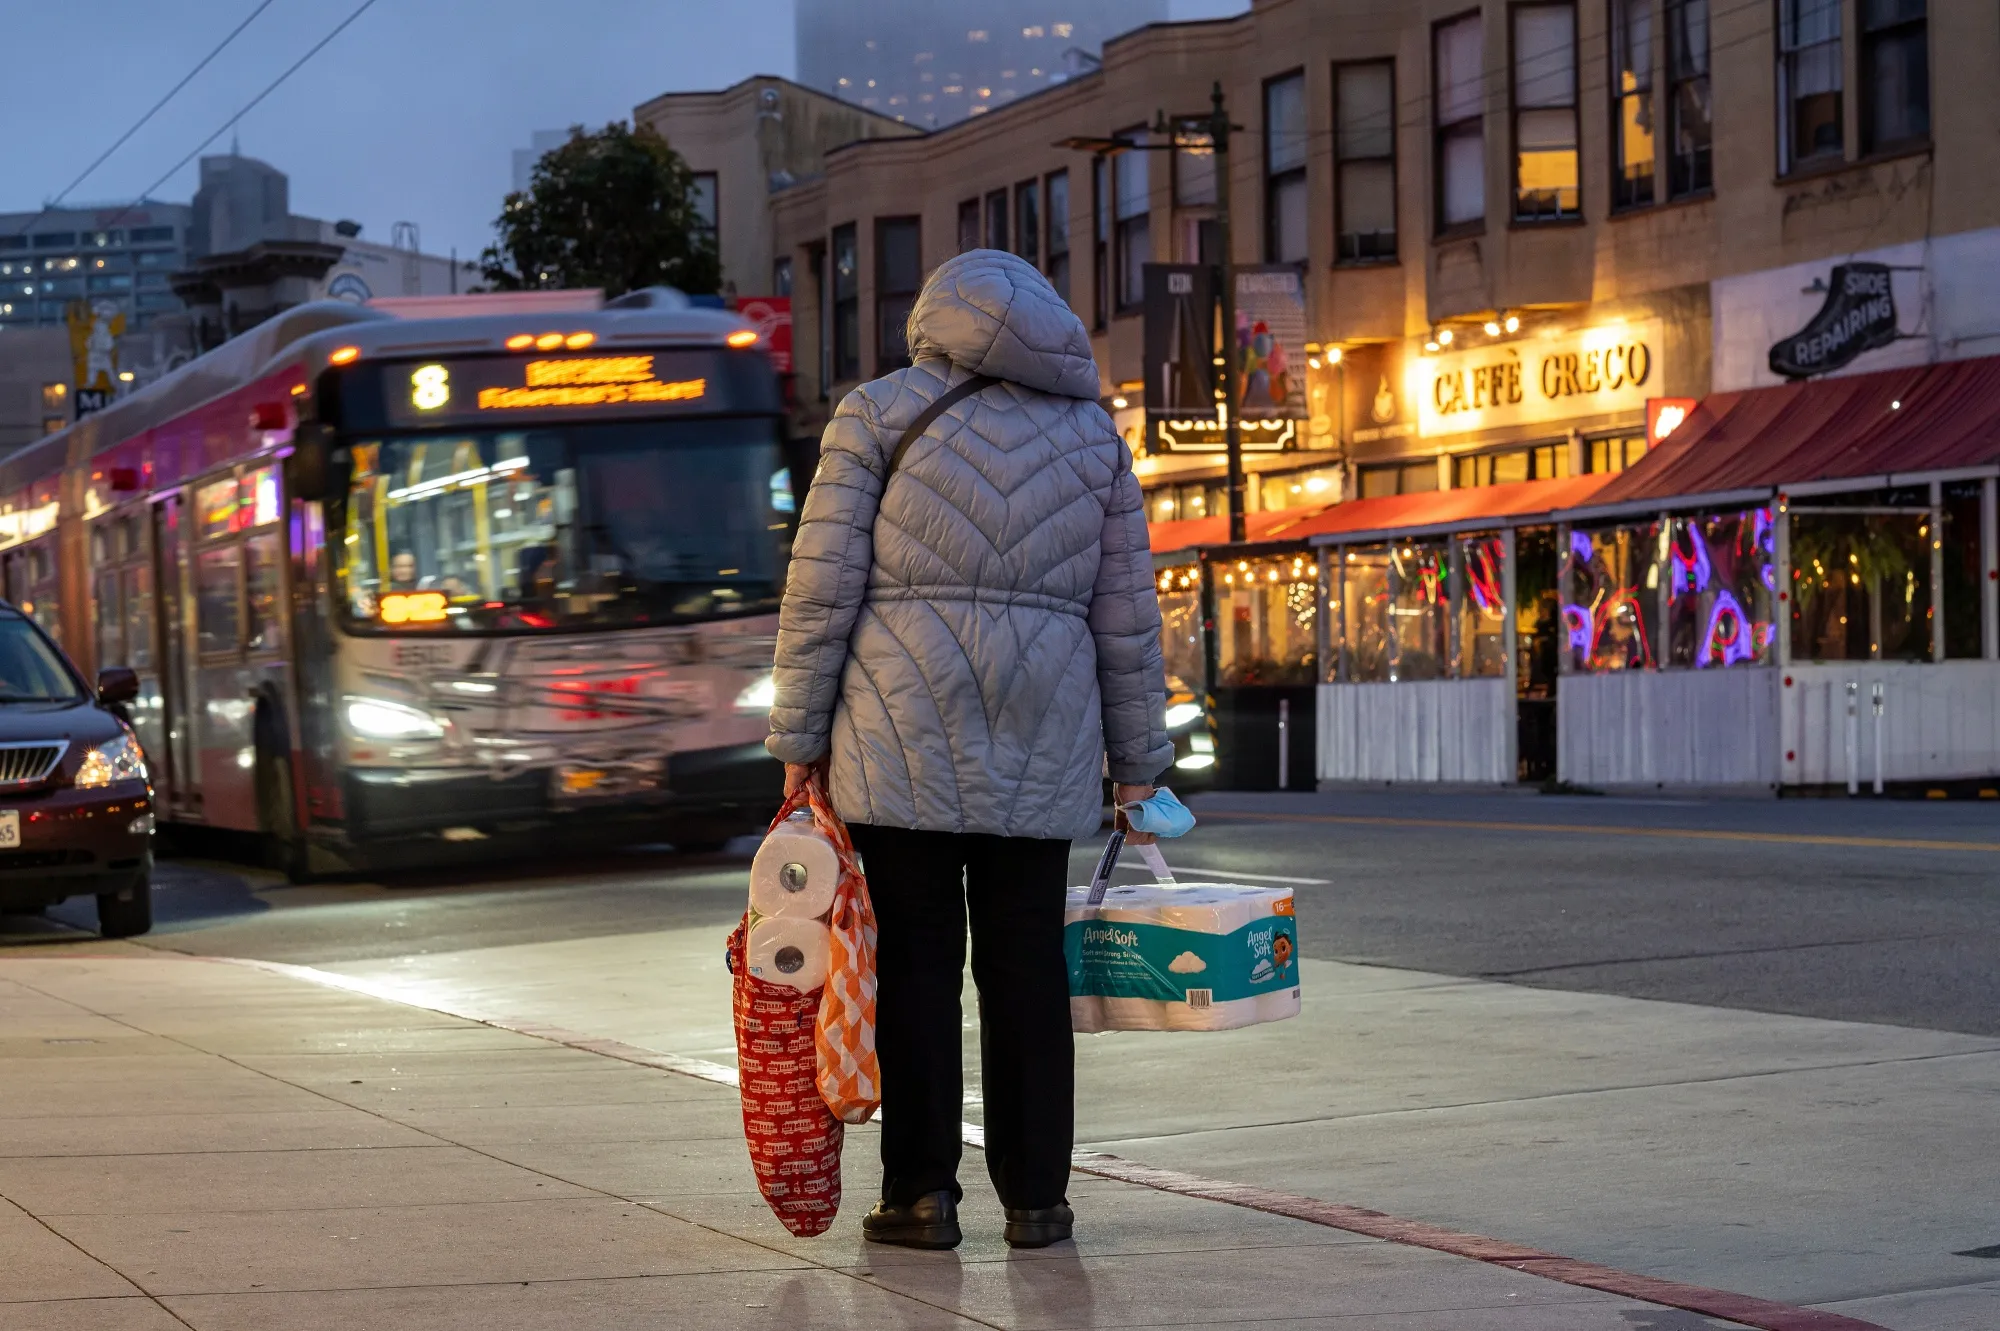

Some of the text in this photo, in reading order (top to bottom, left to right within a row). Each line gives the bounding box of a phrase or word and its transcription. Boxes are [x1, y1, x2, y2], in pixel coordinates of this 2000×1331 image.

[1845, 272, 1889, 295] SHOE
[1795, 296, 1891, 365] REPAIRING
[411, 364, 450, 410] 8
[1434, 342, 1651, 414] CAFFÈ GRECO
[1274, 902, 1285, 912] 16
[1083, 927, 1139, 947] Angel Soft
[1247, 926, 1273, 947] Angel
[1253, 941, 1271, 959] Soft
